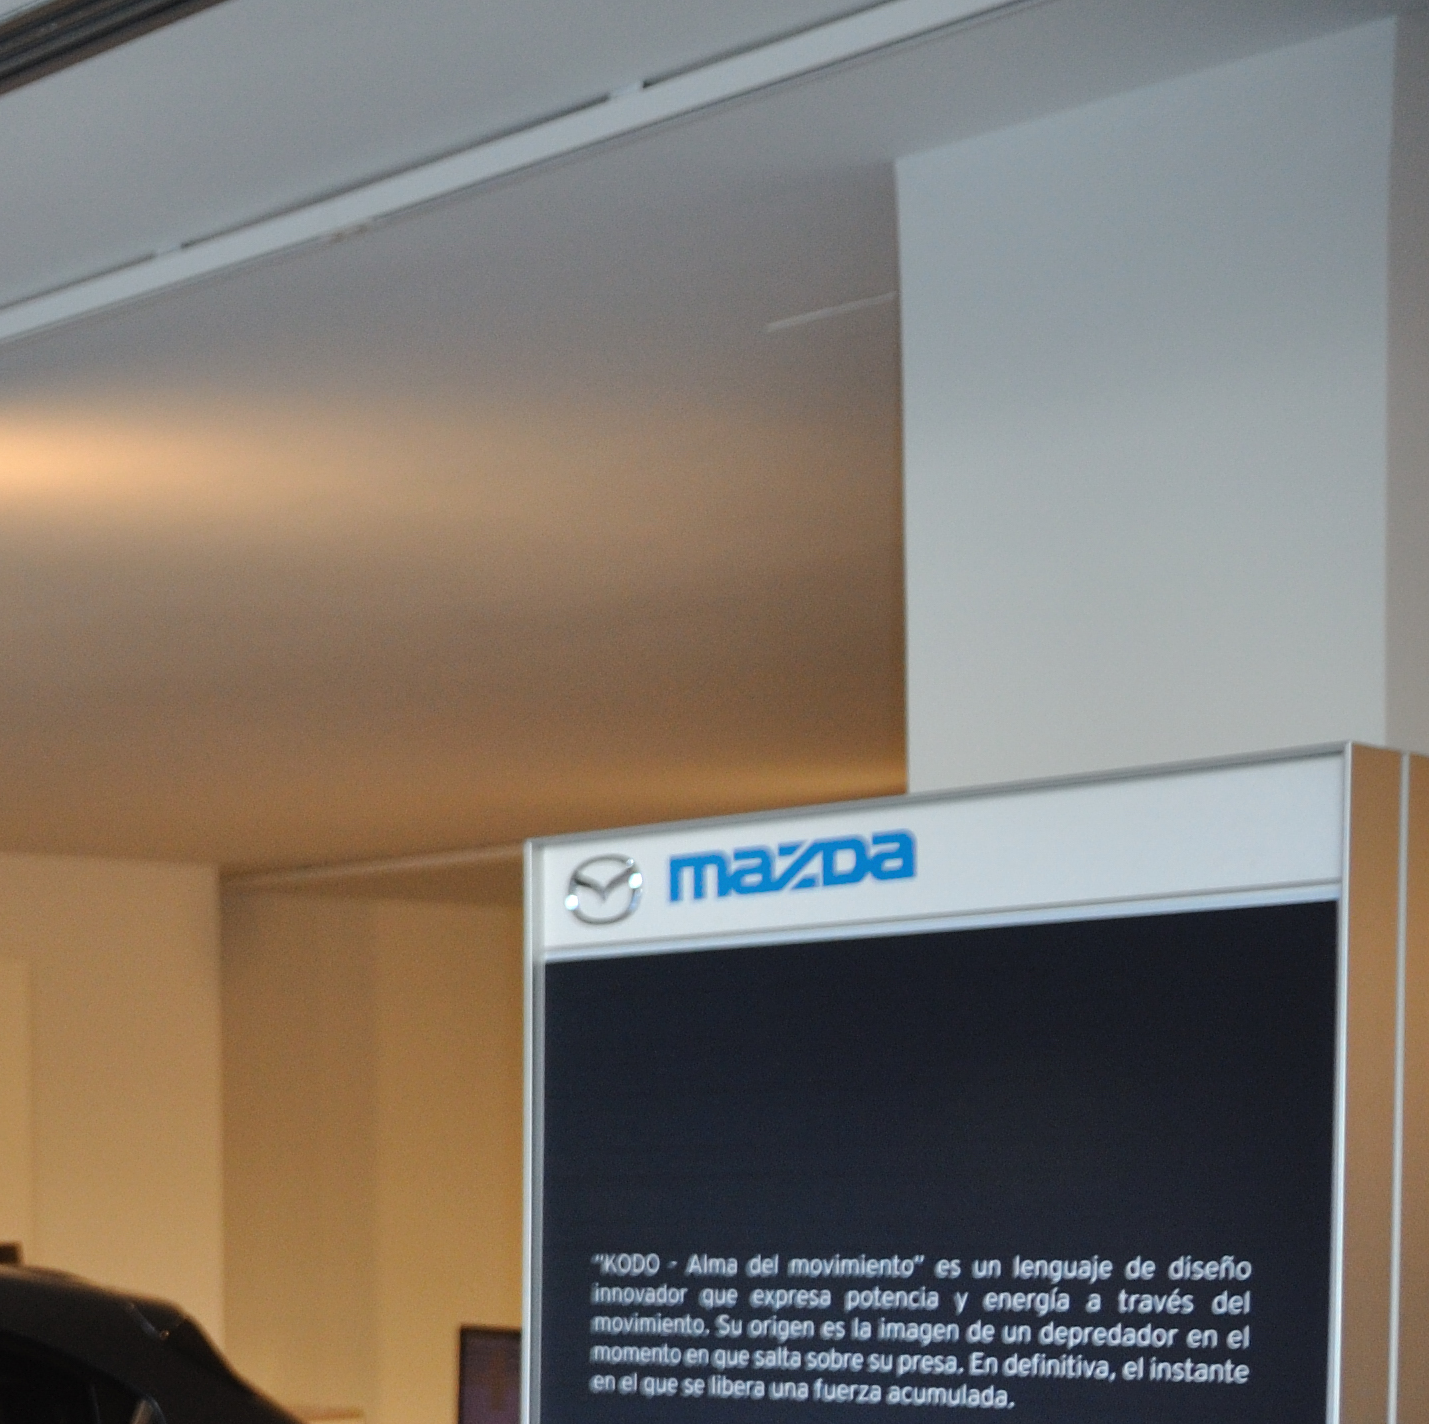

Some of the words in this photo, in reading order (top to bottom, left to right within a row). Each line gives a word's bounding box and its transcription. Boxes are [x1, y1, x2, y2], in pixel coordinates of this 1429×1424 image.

[669, 829, 918, 903] mazda
[686, 1253, 738, 1277] Alma
[746, 1253, 779, 1277] del
[935, 1259, 961, 1278] es
[972, 1259, 1001, 1279] un
[1013, 1255, 1113, 1284] lenguaje
[1125, 1256, 1155, 1280] de
[1168, 1255, 1252, 1280] diseño
[592, 1283, 687, 1306] innovador
[700, 1288, 738, 1309] que
[750, 1289, 831, 1310] expresa
[845, 1286, 939, 1312] potencia
[953, 1292, 968, 1315] y
[983, 1287, 1070, 1316] energía
[1085, 1293, 1101, 1312] a
[1119, 1289, 1194, 1314] través
[1211, 1290, 1252, 1315] del
[591, 1313, 710, 1337] movimiento.
[715, 1314, 742, 1336] Su
[748, 1316, 815, 1343] origen
[821, 1320, 845, 1340] es
[852, 1317, 872, 1340] la
[878, 1318, 959, 1347] imagen
[966, 1320, 995, 1344] de
[1002, 1324, 1031, 1344] un
[1039, 1323, 1179, 1349] depredador
[1187, 1328, 1218, 1349] en
[1227, 1325, 1250, 1349] el
[591, 1343, 681, 1365] momento
[683, 1348, 709, 1365] en
[711, 1349, 749, 1371] que
[753, 1347, 802, 1370] salta
[805, 1348, 863, 1372] sobre
[868, 1352, 892, 1372] su
[897, 1352, 964, 1377] presa.
[968, 1352, 998, 1374] En
[1002, 1354, 1116, 1382] definitiva,
[1122, 1356, 1144, 1380] el
[1149, 1356, 1250, 1383] instante
[590, 1374, 615, 1394] en
[618, 1373, 637, 1394] el
[641, 1374, 678, 1398] que
[680, 1376, 704, 1395] se
[708, 1374, 765, 1397] libera
[769, 1380, 809, 1400] una
[813, 1378, 881, 1403] fuerza
[887, 1384, 1015, 1409] acumulada.
